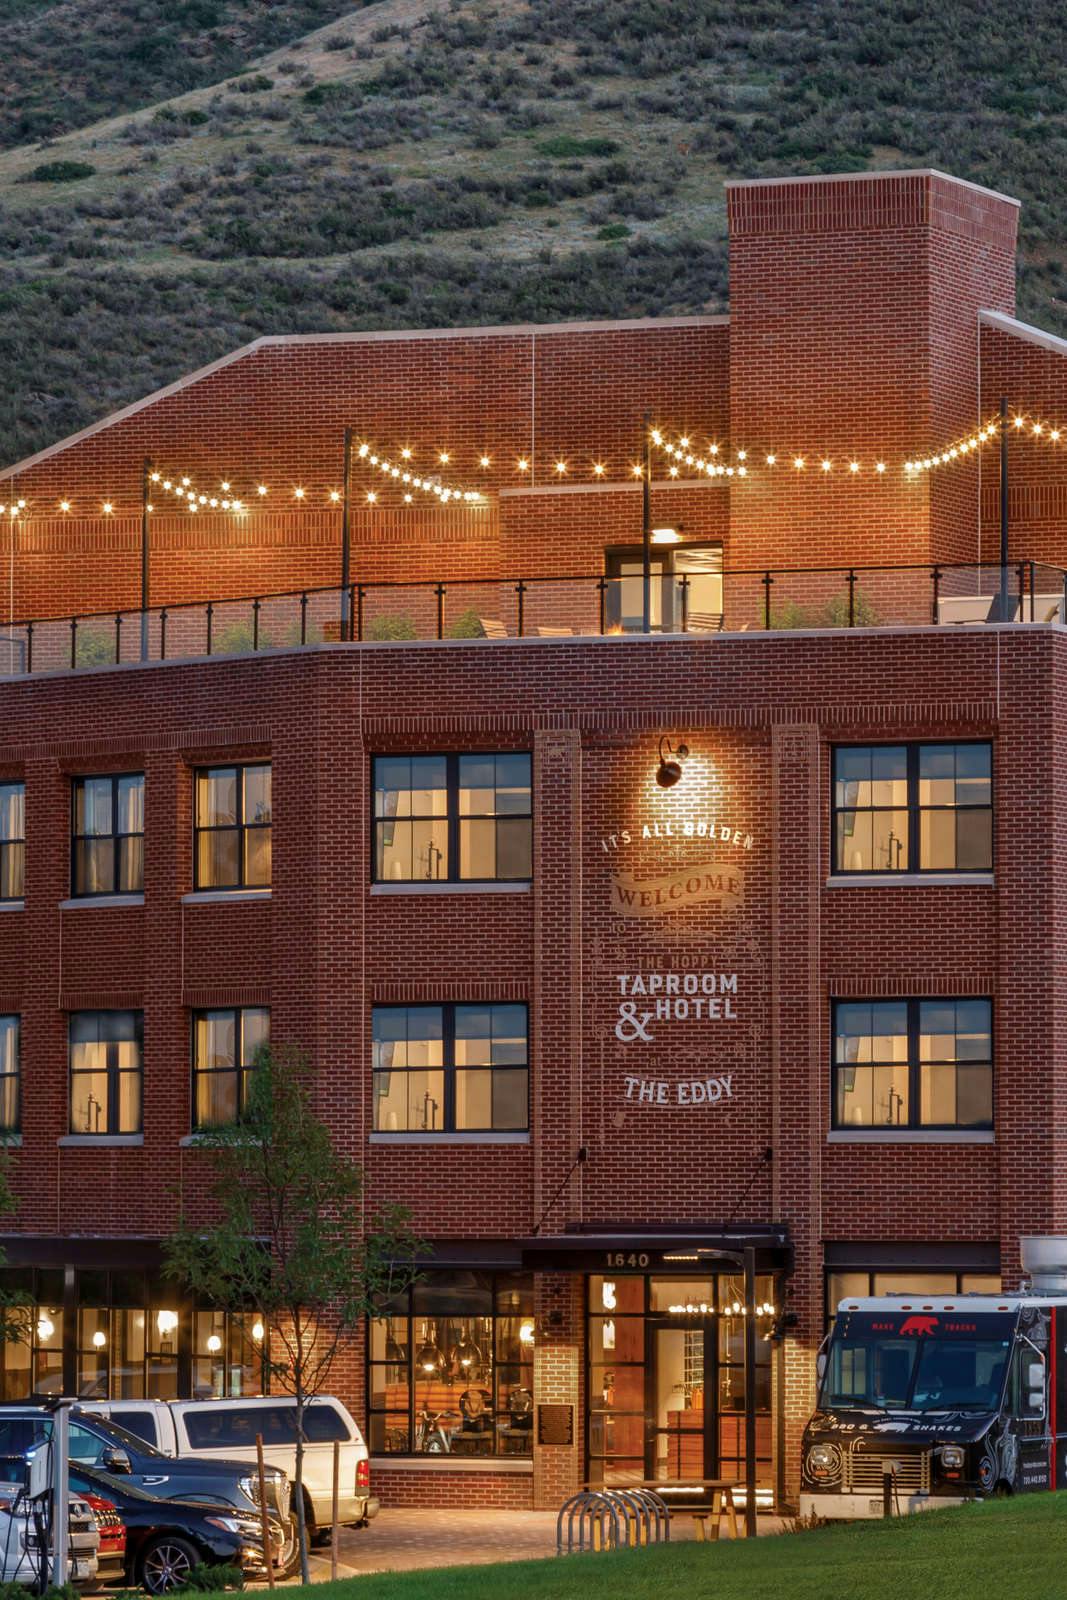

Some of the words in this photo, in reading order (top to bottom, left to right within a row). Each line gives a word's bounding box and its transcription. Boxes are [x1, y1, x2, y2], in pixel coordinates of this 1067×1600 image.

[642, 821, 674, 840] ALL
[683, 821, 754, 850] GOLDEN
[615, 874, 741, 907] WELCOME
[637, 955, 665, 969] THE
[671, 955, 718, 969] HOPPY
[616, 973, 738, 996] TAPROOM
[615, 1001, 654, 1041] &
[655, 998, 737, 1020] HOTEL
[624, 1076, 669, 1105] THE
[677, 1075, 733, 1105] EDDY
[607, 1253, 649, 1267] 1640
[912, 1424, 962, 1432] SHAKES
